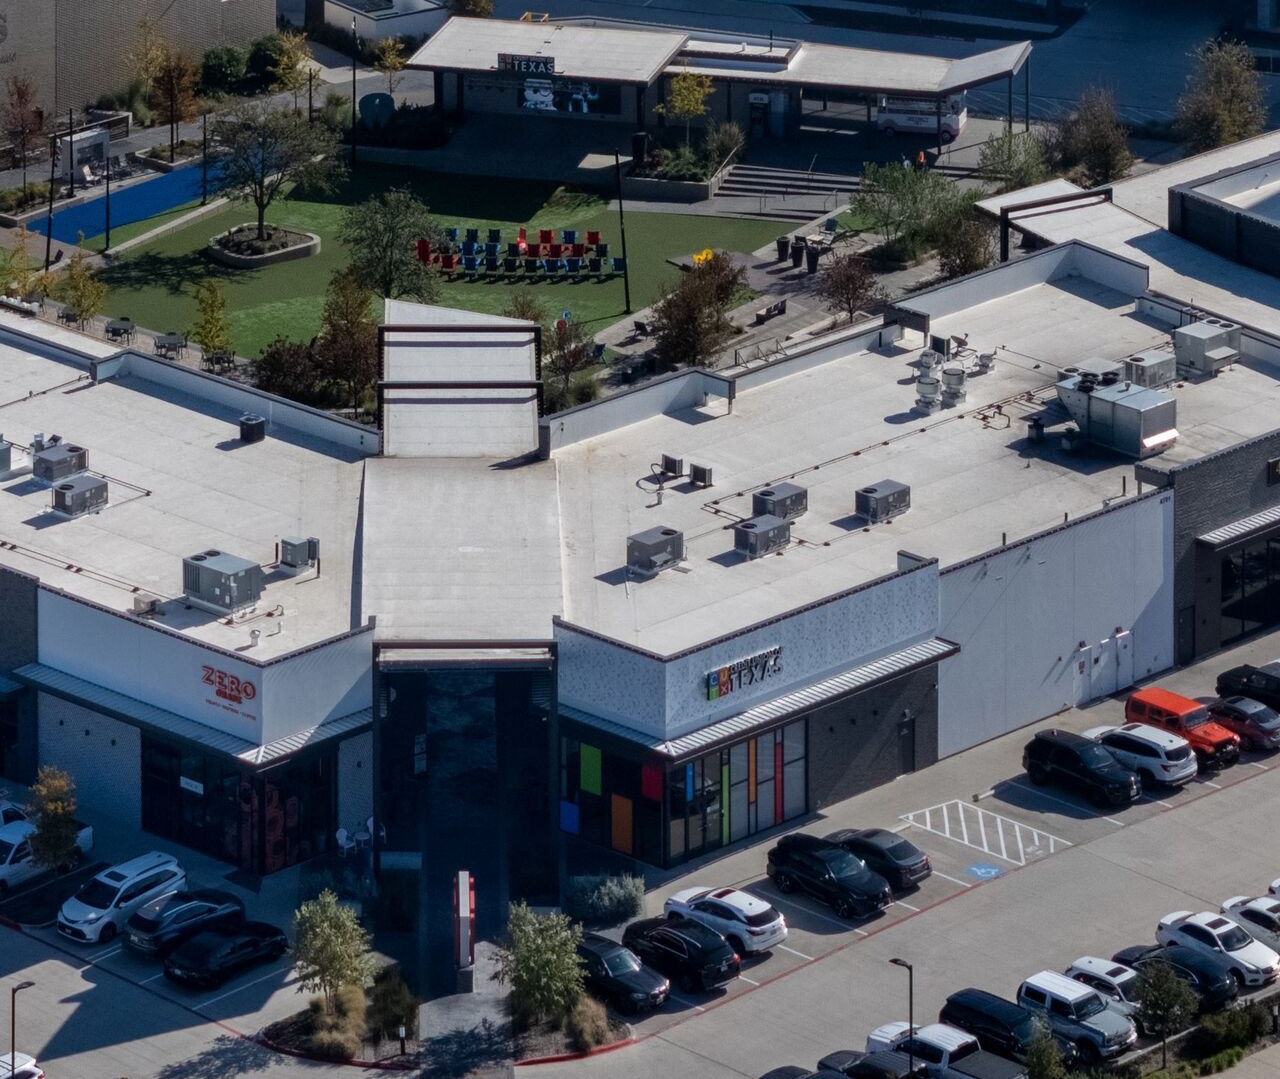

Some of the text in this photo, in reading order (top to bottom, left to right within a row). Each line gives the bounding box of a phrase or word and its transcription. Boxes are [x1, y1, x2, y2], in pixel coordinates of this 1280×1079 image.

[513, 60, 554, 73] TEXAS
[201, 665, 256, 700] ZERO
[729, 654, 783, 691] TEXAS
